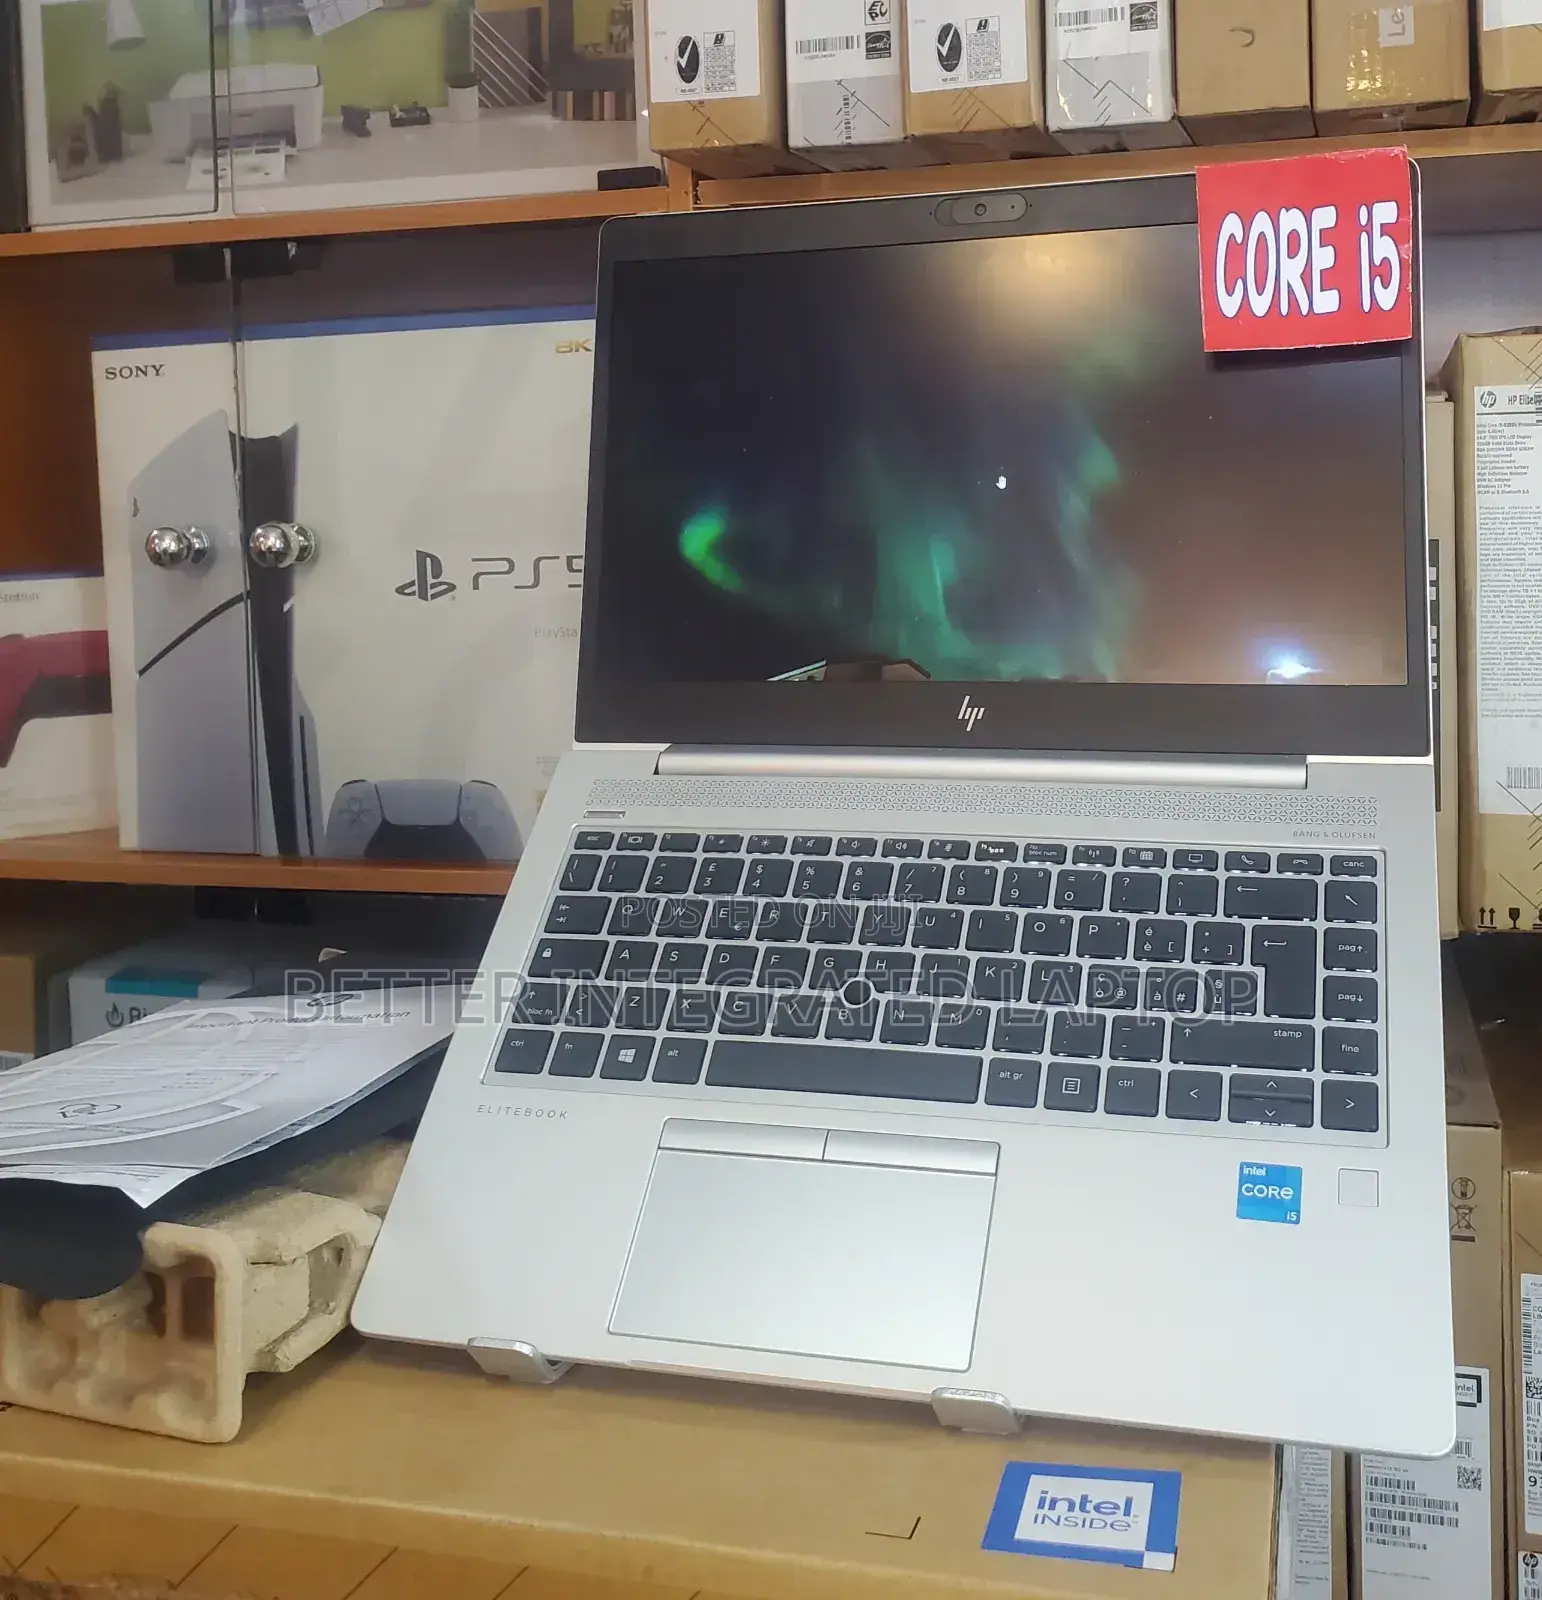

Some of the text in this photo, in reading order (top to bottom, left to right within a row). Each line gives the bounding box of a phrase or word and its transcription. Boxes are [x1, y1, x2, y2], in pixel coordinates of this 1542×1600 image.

[1215, 201, 1401, 319] CORE i5
[554, 340, 593, 353] 8K
[104, 364, 166, 380] SONY
[1508, 396, 1517, 405] HP
[957, 695, 986, 732] hp
[1332, 832, 1376, 840] OLUFSEN
[756, 864, 764, 874] $
[806, 866, 815, 876] %
[855, 867, 864, 876] &
[654, 876, 664, 885] 2
[704, 877, 712, 886] 3
[752, 878, 760, 888] 4
[802, 880, 810, 890] 5
[852, 882, 861, 892] 6
[904, 884, 914, 893] 7
[957, 886, 966, 896] 8
[1010, 888, 1020, 898] 9
[622, 904, 634, 915] Q
[672, 906, 686, 916] W
[719, 910, 728, 918] E
[768, 910, 779, 920] R
[925, 916, 936, 926] U
[1034, 922, 1046, 932] O
[1088, 924, 1098, 935] P
[1338, 944, 1356, 952] pag
[619, 949, 630, 960] A
[669, 950, 678, 961] S
[719, 954, 730, 962] D
[770, 955, 780, 965] F
[824, 957, 834, 968] G
[876, 960, 886, 970] H
[929, 962, 938, 974] J
[985, 966, 996, 978] K
[1041, 970, 1050, 980] L
[1114, 988, 1127, 998] @
[1176, 992, 1186, 1002] #
[1338, 992, 1356, 1001] pag
[628, 996, 640, 1008] Z
[680, 998, 692, 1010] X
[732, 1001, 744, 1012] C
[788, 1004, 798, 1014] V
[838, 1008, 849, 1020] B
[893, 1010, 904, 1020] N
[950, 1013, 962, 1024] M
[1273, 1029, 1302, 1039] stamp
[564, 1042, 573, 1050] fn
[1341, 1044, 1360, 1053] fine
[668, 1048, 679, 1056] alt
[999, 1070, 1024, 1080] alt gr
[1118, 1078, 1134, 1088] ctrl
[477, 1104, 568, 1120] ELITEBOOK
[1243, 1165, 1266, 1176] intel
[1286, 1211, 1298, 1221] i5
